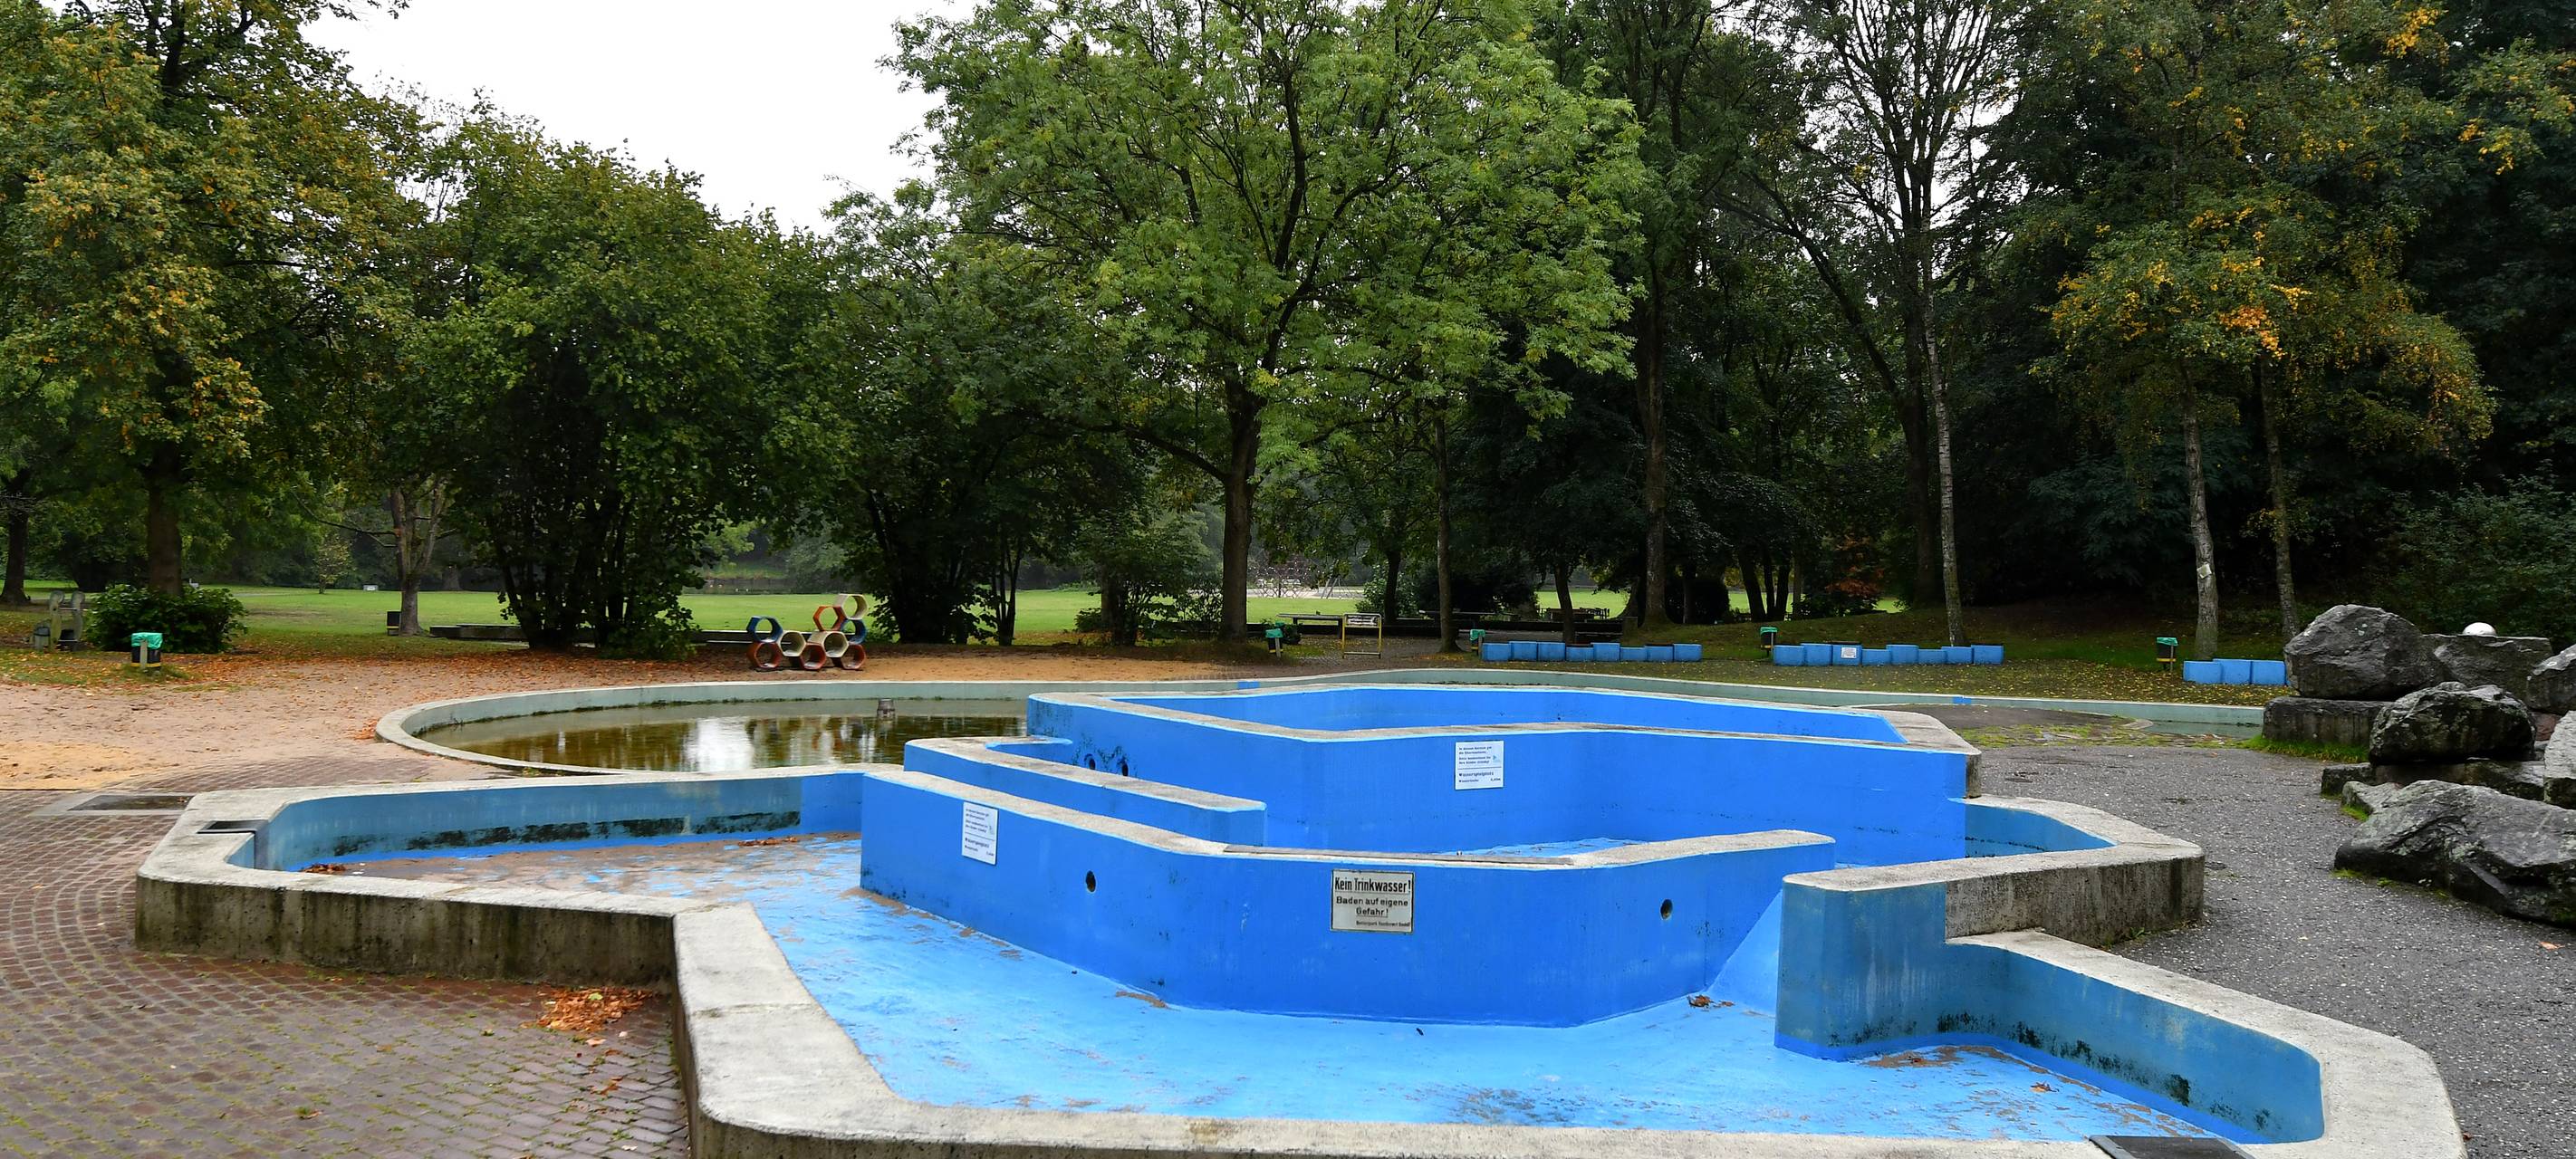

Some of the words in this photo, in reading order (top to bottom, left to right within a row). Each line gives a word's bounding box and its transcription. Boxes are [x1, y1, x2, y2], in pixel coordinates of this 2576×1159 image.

[1335, 876, 1352, 890] Kein
[1354, 877, 1411, 893] Trinkwasser!
[1336, 896, 1363, 905] Baden
[1365, 897, 1379, 905] auf
[1380, 897, 1408, 907] eigene
